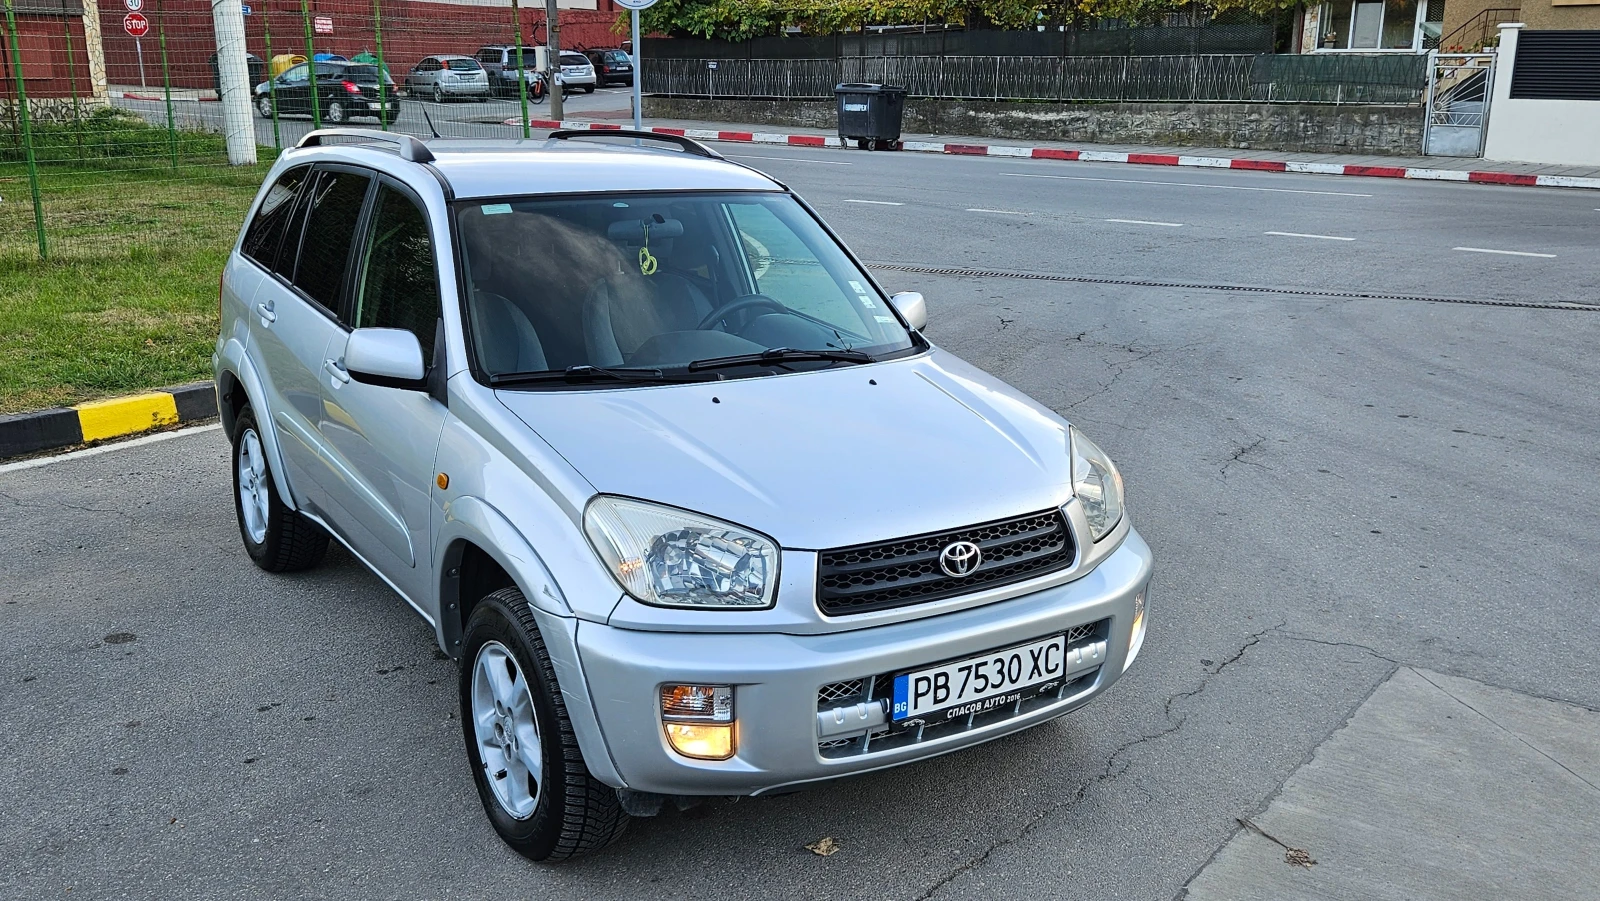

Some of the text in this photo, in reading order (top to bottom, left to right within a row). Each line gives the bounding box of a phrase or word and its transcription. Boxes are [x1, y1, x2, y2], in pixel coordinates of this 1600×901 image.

[126, 20, 146, 30] STOP
[913, 642, 1060, 710] PB 7530 XC
[894, 701, 907, 713] BG
[946, 692, 1021, 719] СПАСОВ АУТО 2016
